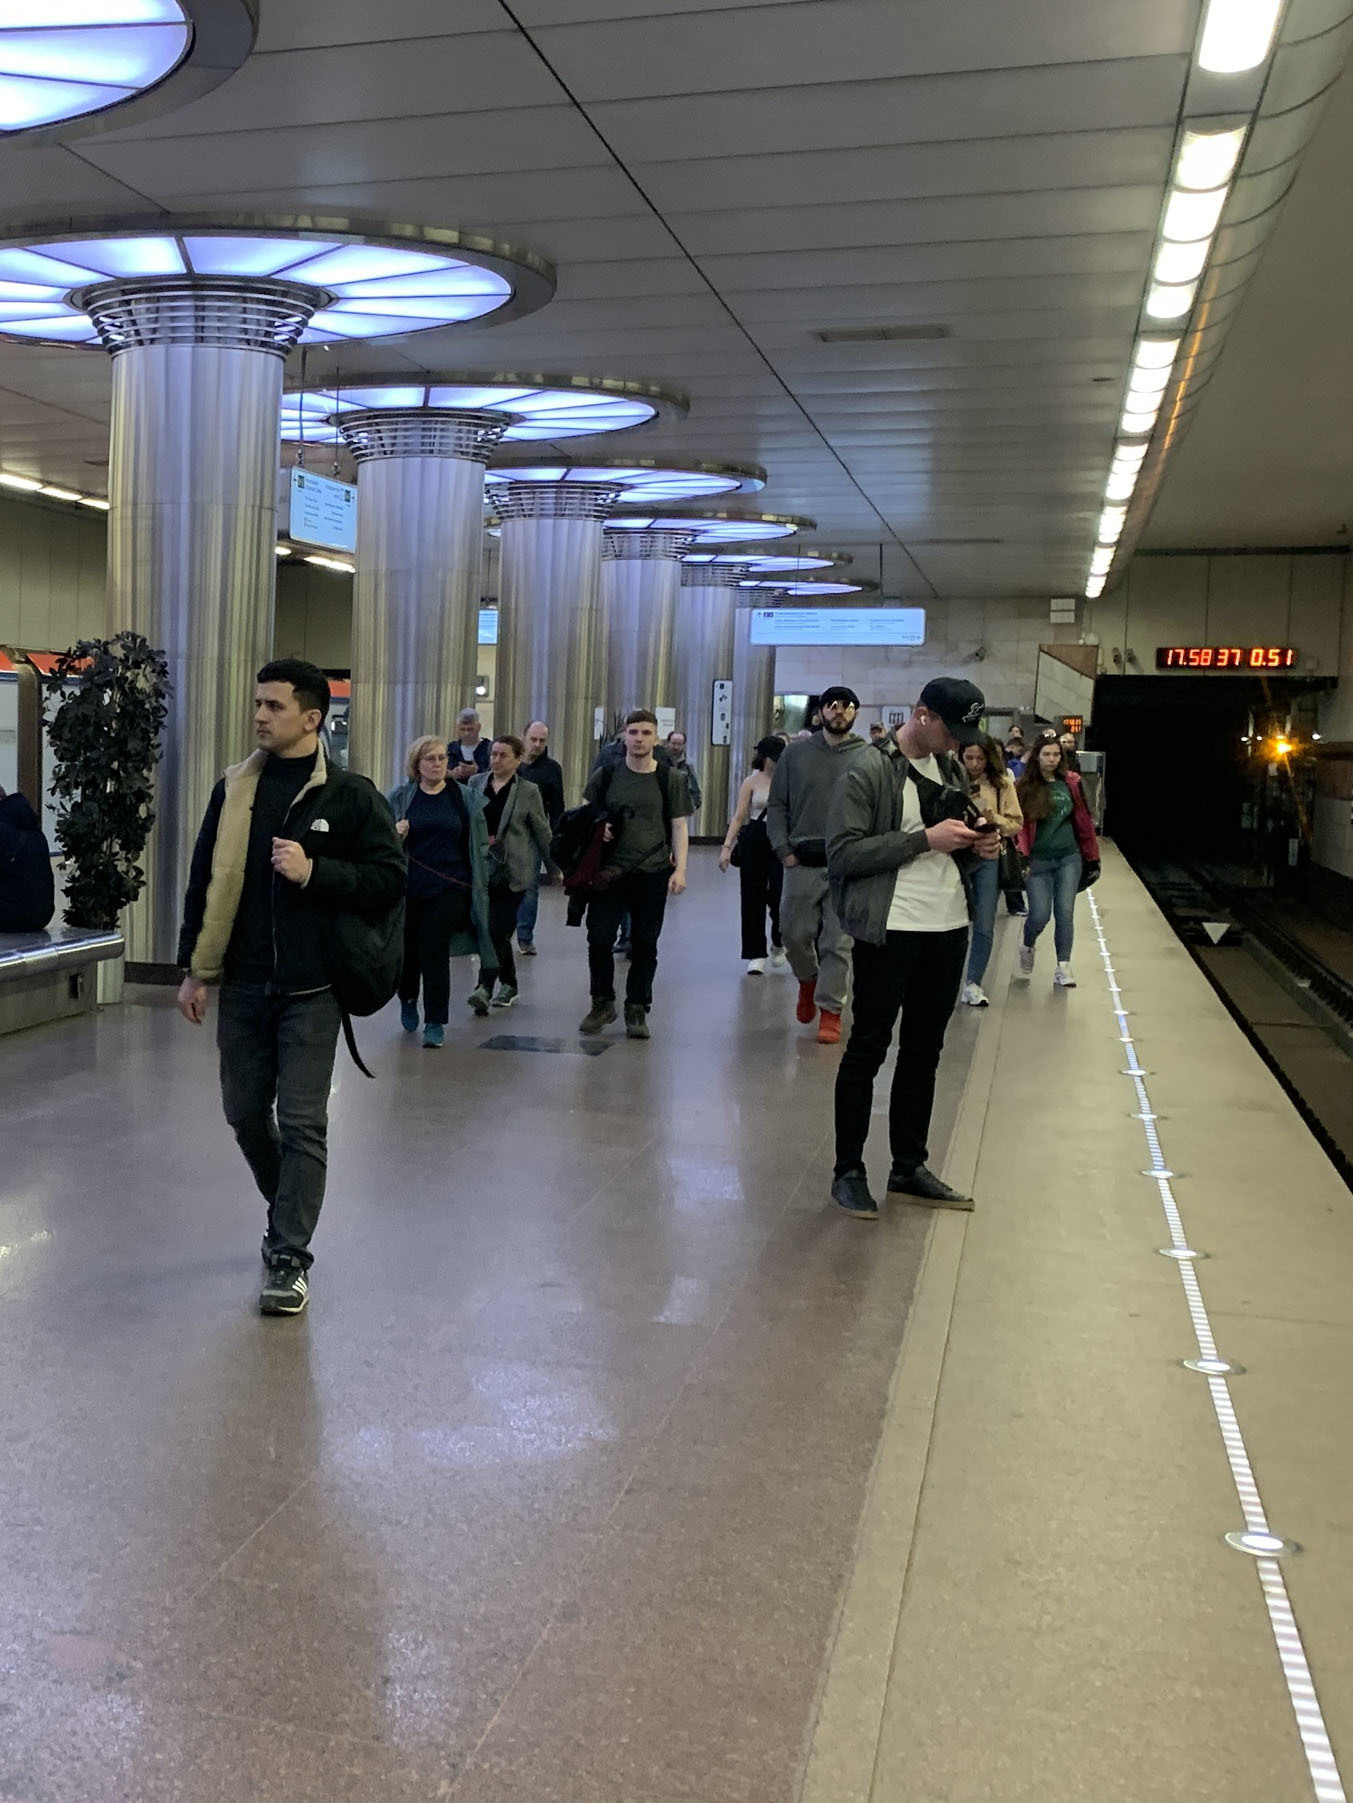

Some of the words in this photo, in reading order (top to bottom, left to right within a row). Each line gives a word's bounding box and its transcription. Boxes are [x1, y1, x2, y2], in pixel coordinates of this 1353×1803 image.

[1167, 648, 1213, 666] 17.58
[1216, 648, 1241, 666] 37
[1250, 648, 1293, 667] 0.51
